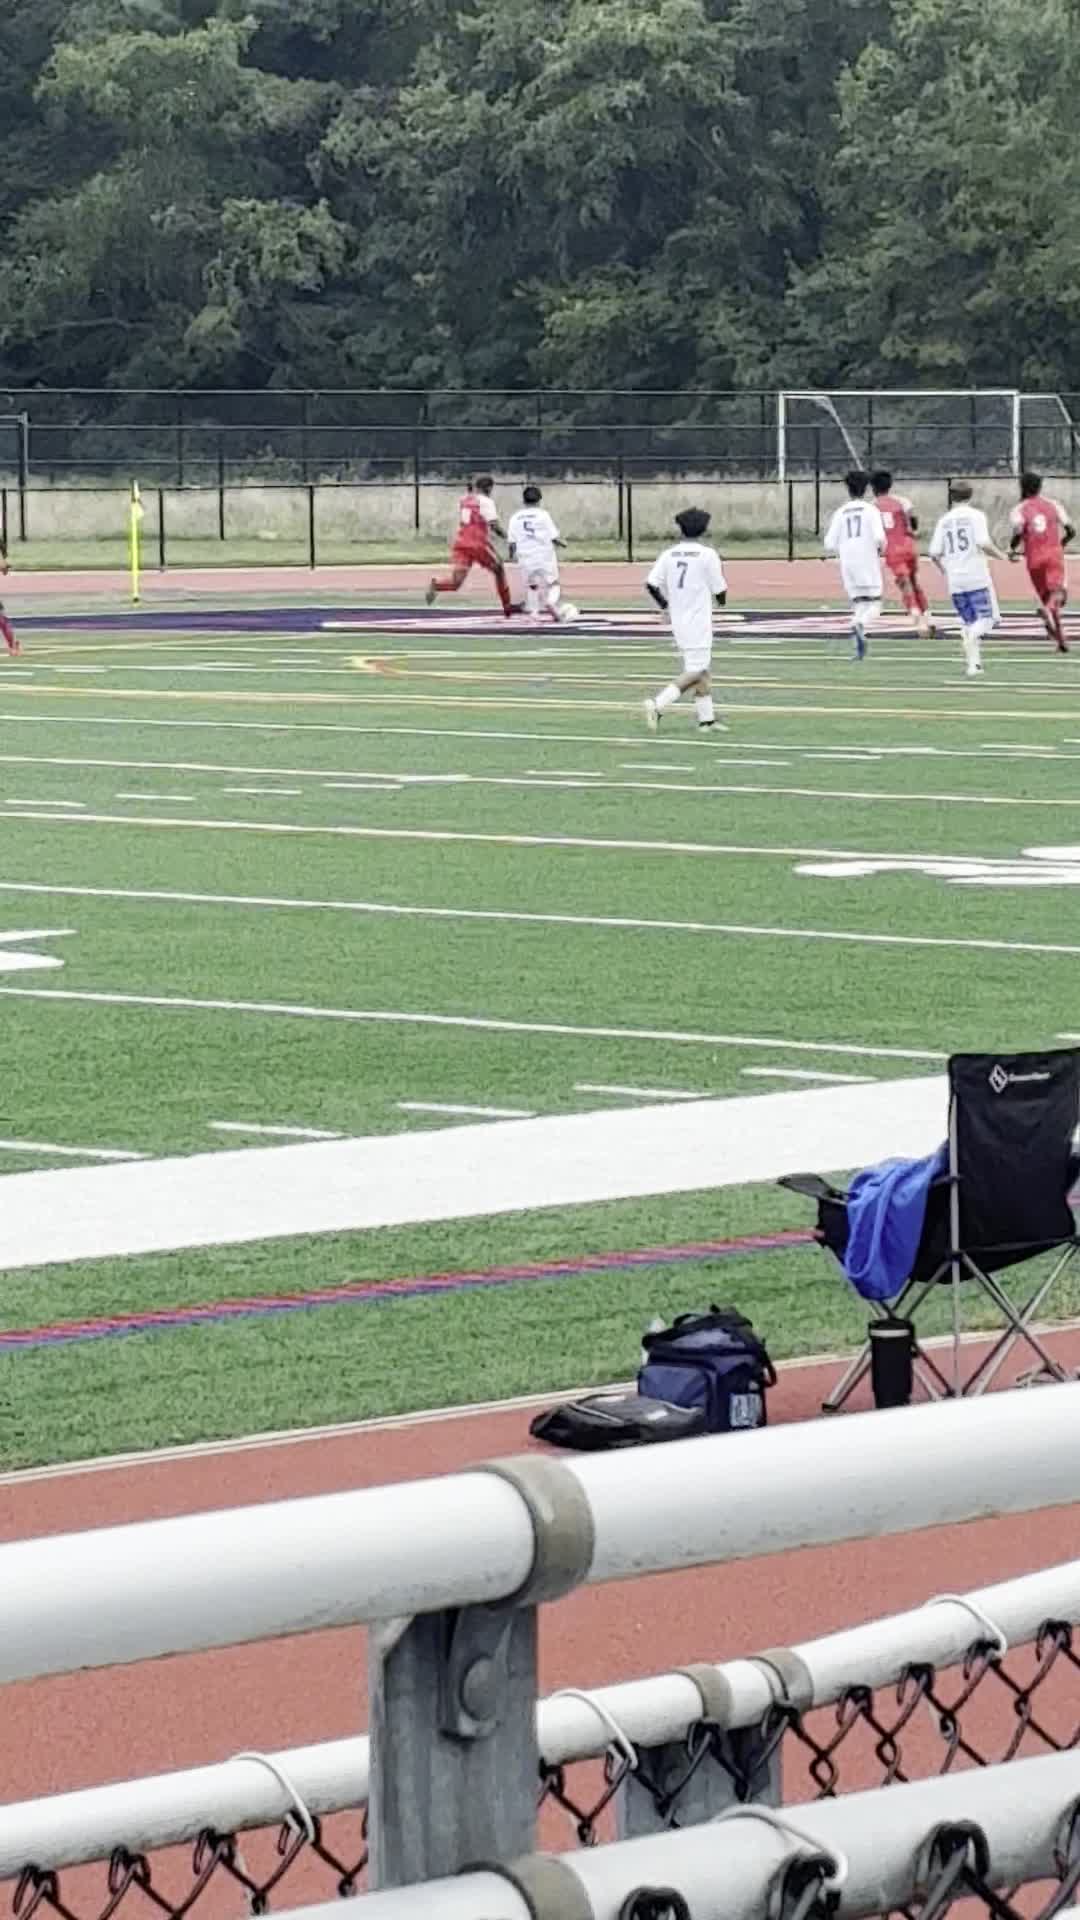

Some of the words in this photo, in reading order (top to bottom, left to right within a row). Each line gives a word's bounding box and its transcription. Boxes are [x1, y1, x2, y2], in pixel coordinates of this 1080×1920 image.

[523, 521, 535, 538] 5
[847, 515, 861, 538] 17
[947, 528, 969, 553] 15
[677, 561, 688, 588] 7
